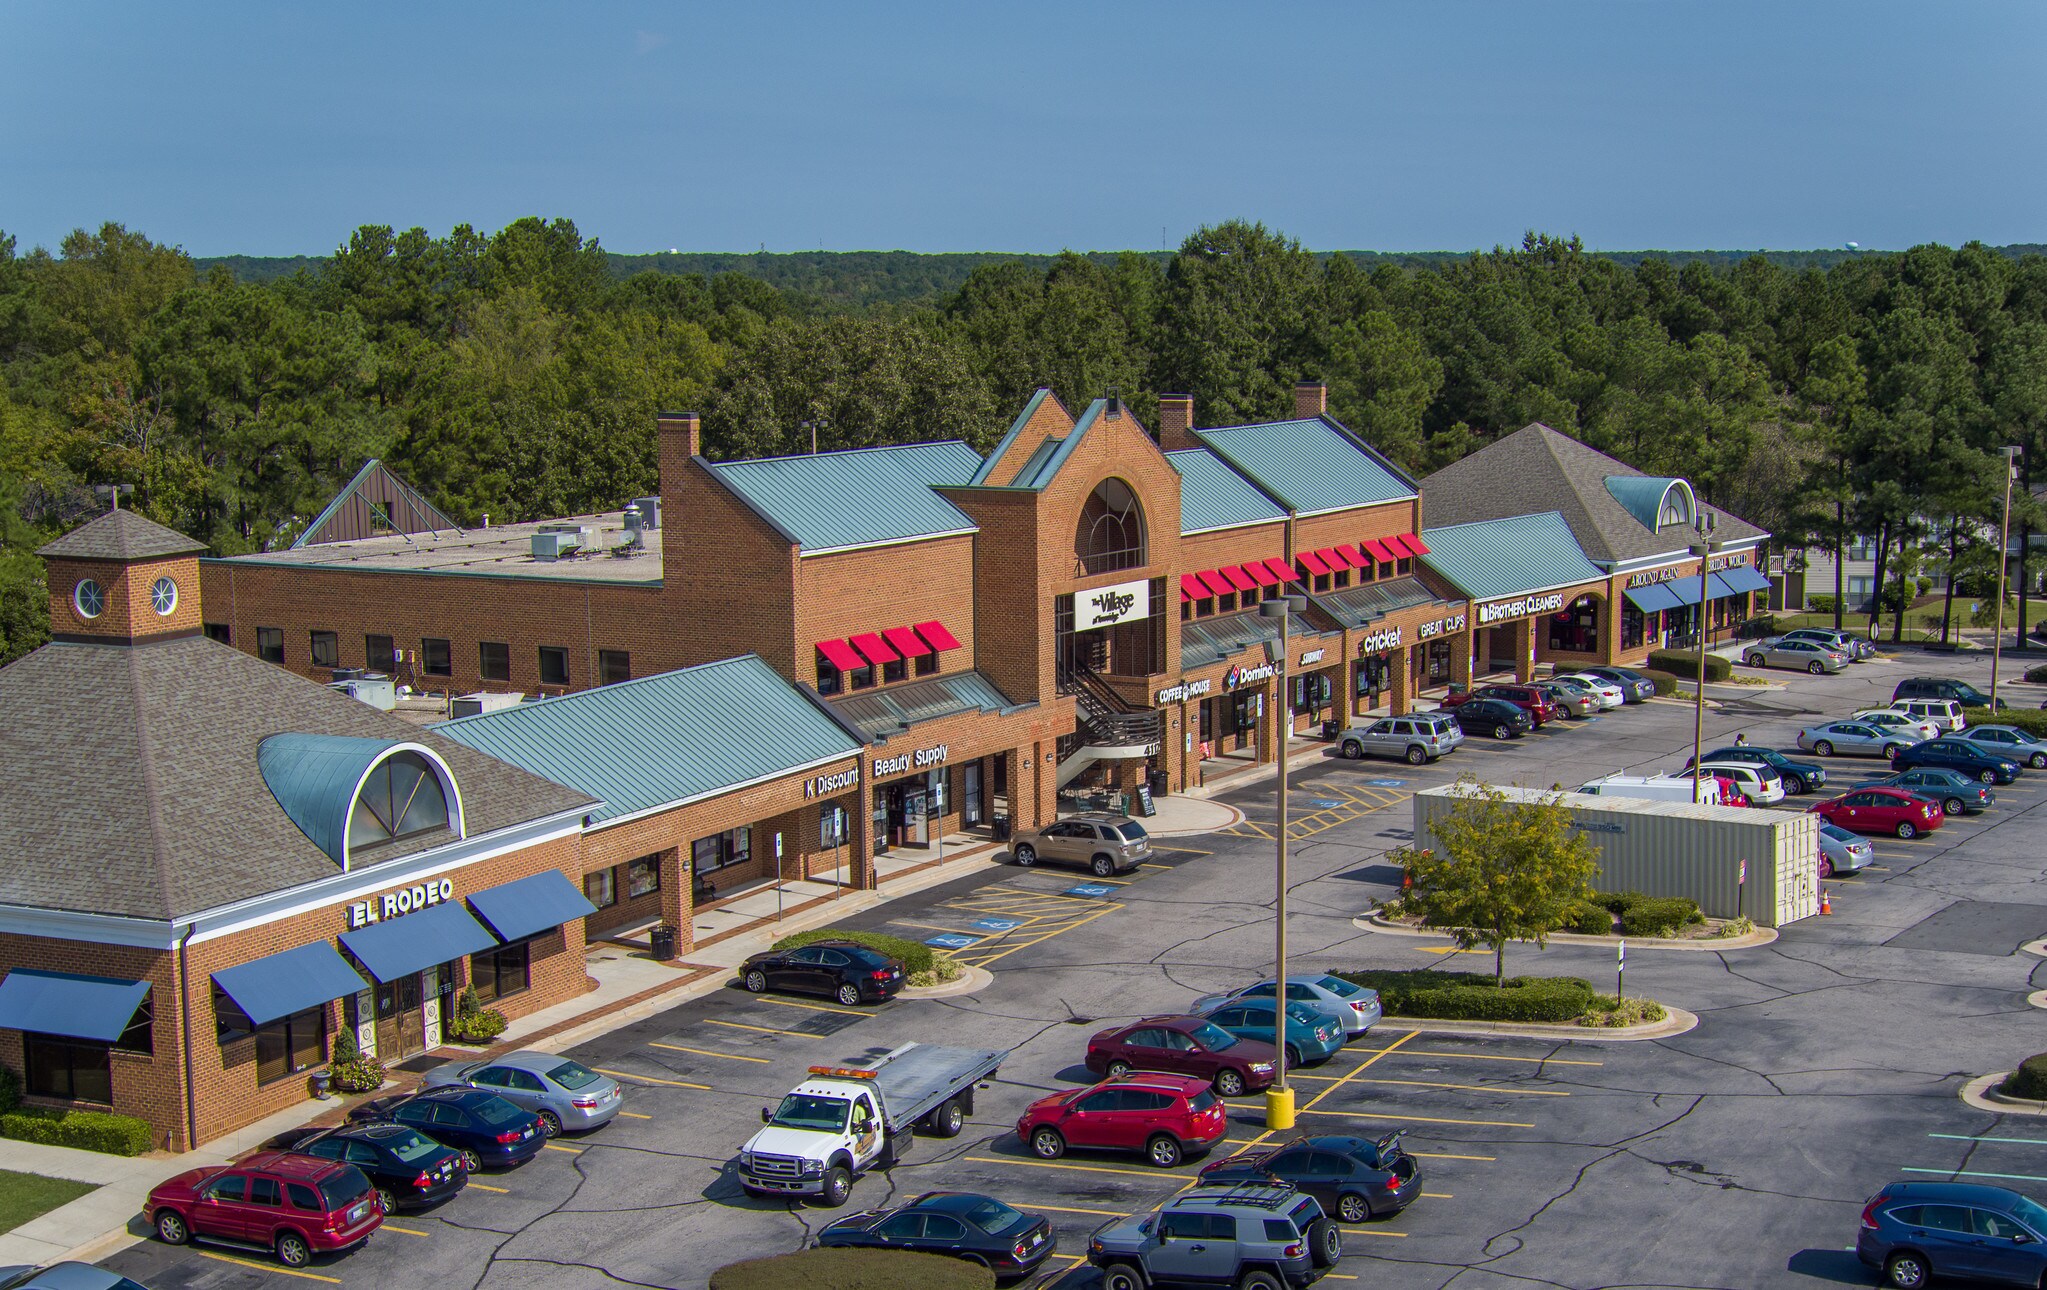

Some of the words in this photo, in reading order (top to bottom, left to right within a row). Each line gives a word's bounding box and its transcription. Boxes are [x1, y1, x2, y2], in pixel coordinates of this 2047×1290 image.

[1728, 553, 1748, 567] WORLD
[1630, 571, 1658, 587] AROUND
[1659, 566, 1679, 581] AGAIN
[1099, 591, 1134, 615] Village
[1488, 601, 1526, 621] BROTHERS
[1526, 594, 1562, 614] CLEANERS
[1421, 620, 1443, 638] GREAT
[1446, 614, 1465, 632] CLIPS
[1364, 626, 1402, 653] cricket
[1240, 660, 1277, 684] Domino'
[1159, 686, 1182, 704] COFFEE
[1189, 679, 1210, 696] HOUSE
[874, 754, 911, 777] Beauty
[915, 744, 948, 766] Supply
[806, 780, 814, 798] K
[818, 766, 859, 795] Discount
[352, 899, 378, 928] EL
[383, 878, 453, 917] RODEO
